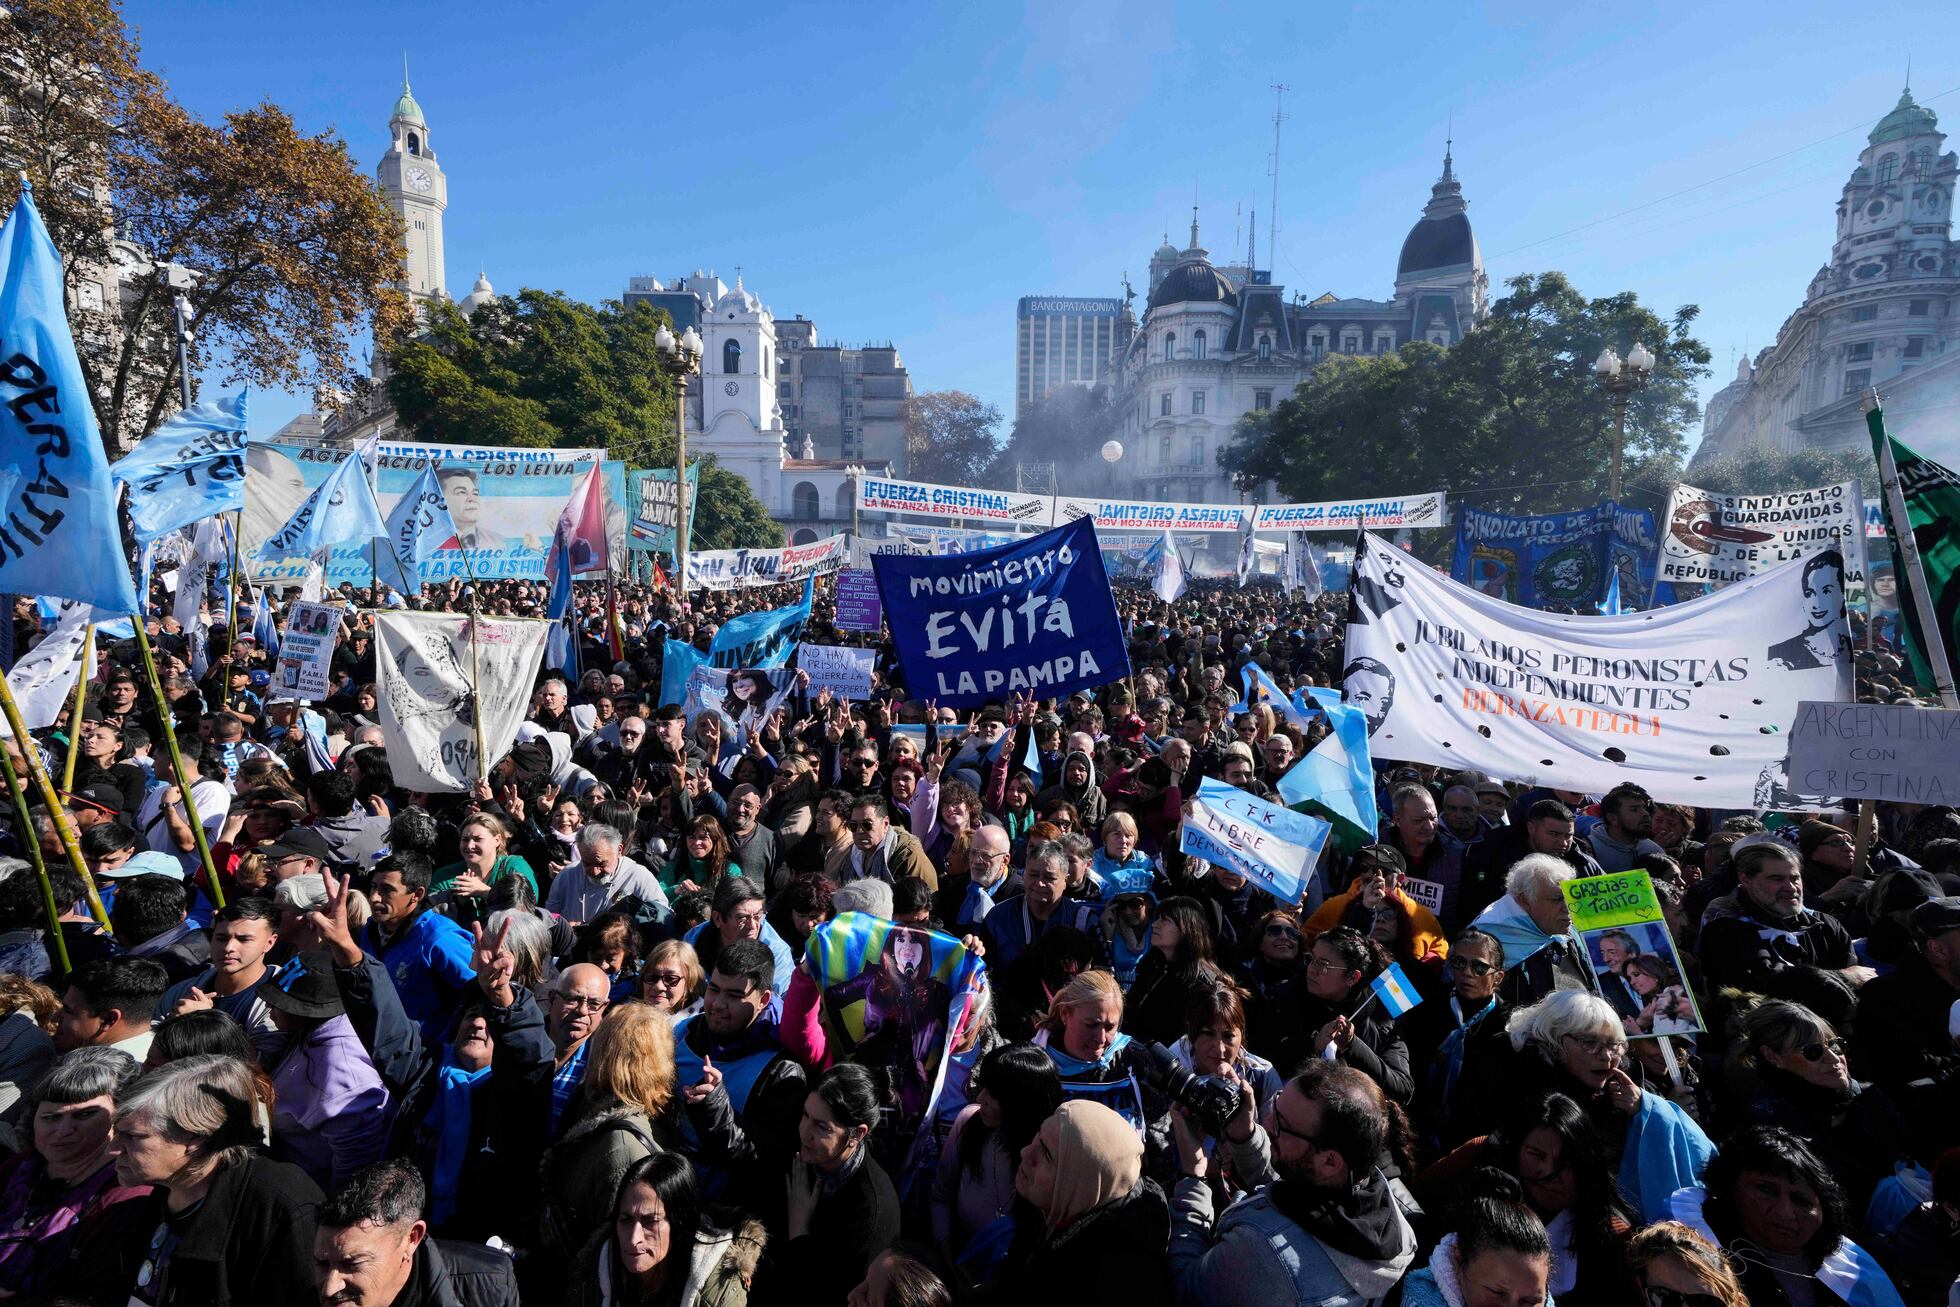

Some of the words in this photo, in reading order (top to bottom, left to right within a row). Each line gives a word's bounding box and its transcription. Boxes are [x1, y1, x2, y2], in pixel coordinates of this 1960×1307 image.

[483, 462, 516, 475] LOS
[525, 462, 574, 476] LEIVA
[933, 489, 1008, 511] CRISTINA!
[1725, 485, 1842, 510] SINDICATO
[865, 498, 877, 507] LA
[881, 501, 930, 513] MATANZA
[962, 506, 983, 517] CON
[987, 509, 1008, 519] VOS
[1328, 501, 1404, 518] CRISTINA!
[1724, 501, 1843, 524] GUARDAVIDAS
[1259, 521, 1272, 529] LA
[1275, 519, 1324, 528] MATANZA
[1383, 516, 1403, 525] VOS
[1566, 514, 1588, 528] DE
[1783, 523, 1853, 543] UNIDOS
[1735, 549, 1758, 561] DE
[1778, 549, 1802, 561] LA
[910, 544, 1073, 598] movimiento
[1664, 563, 1755, 583] REPUBLIC
[802, 648, 820, 658] NO
[1414, 619, 1541, 668] JUBILADOS
[1553, 653, 1749, 682] PERONISTAS
[808, 671, 847, 681] NCIERRE
[937, 671, 978, 696] LA
[984, 650, 1101, 692] PAMPA
[1452, 657, 1691, 711] INDEPENDIENTES
[1463, 687, 1660, 737] BERAZATEGUI
[1799, 703, 1960, 741] ARGENTINA
[1850, 747, 1896, 761] CON
[1805, 769, 1945, 801] CRISTINA
[1402, 882, 1438, 899] MILEI
